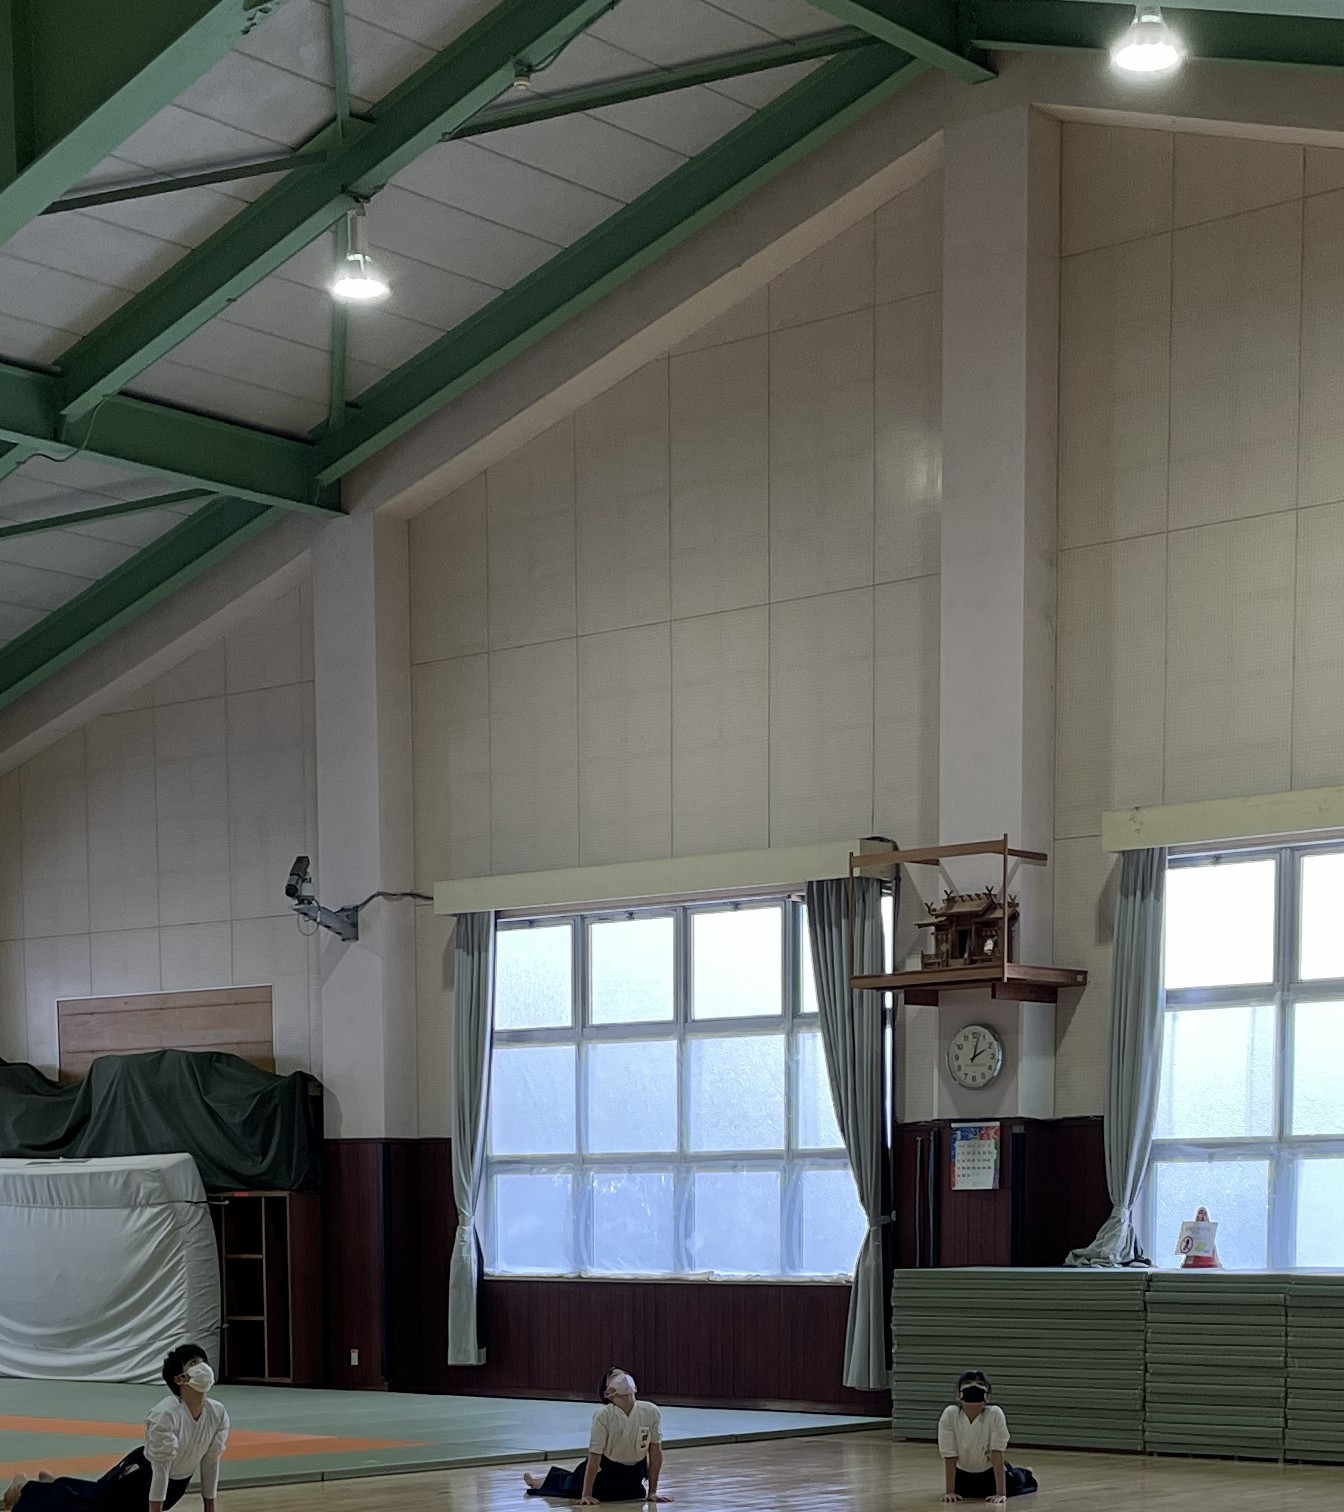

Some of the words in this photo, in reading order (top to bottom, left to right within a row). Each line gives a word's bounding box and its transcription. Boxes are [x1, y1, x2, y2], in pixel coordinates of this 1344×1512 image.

[987, 1041, 993, 1050] 2
[954, 1053, 960, 1061] 9
[990, 1052, 996, 1061] 3
[956, 1064, 962, 1072] 8
[963, 1072, 969, 1080] 7
[971, 1074, 977, 1083] 6
[981, 1071, 986, 1080] 5
